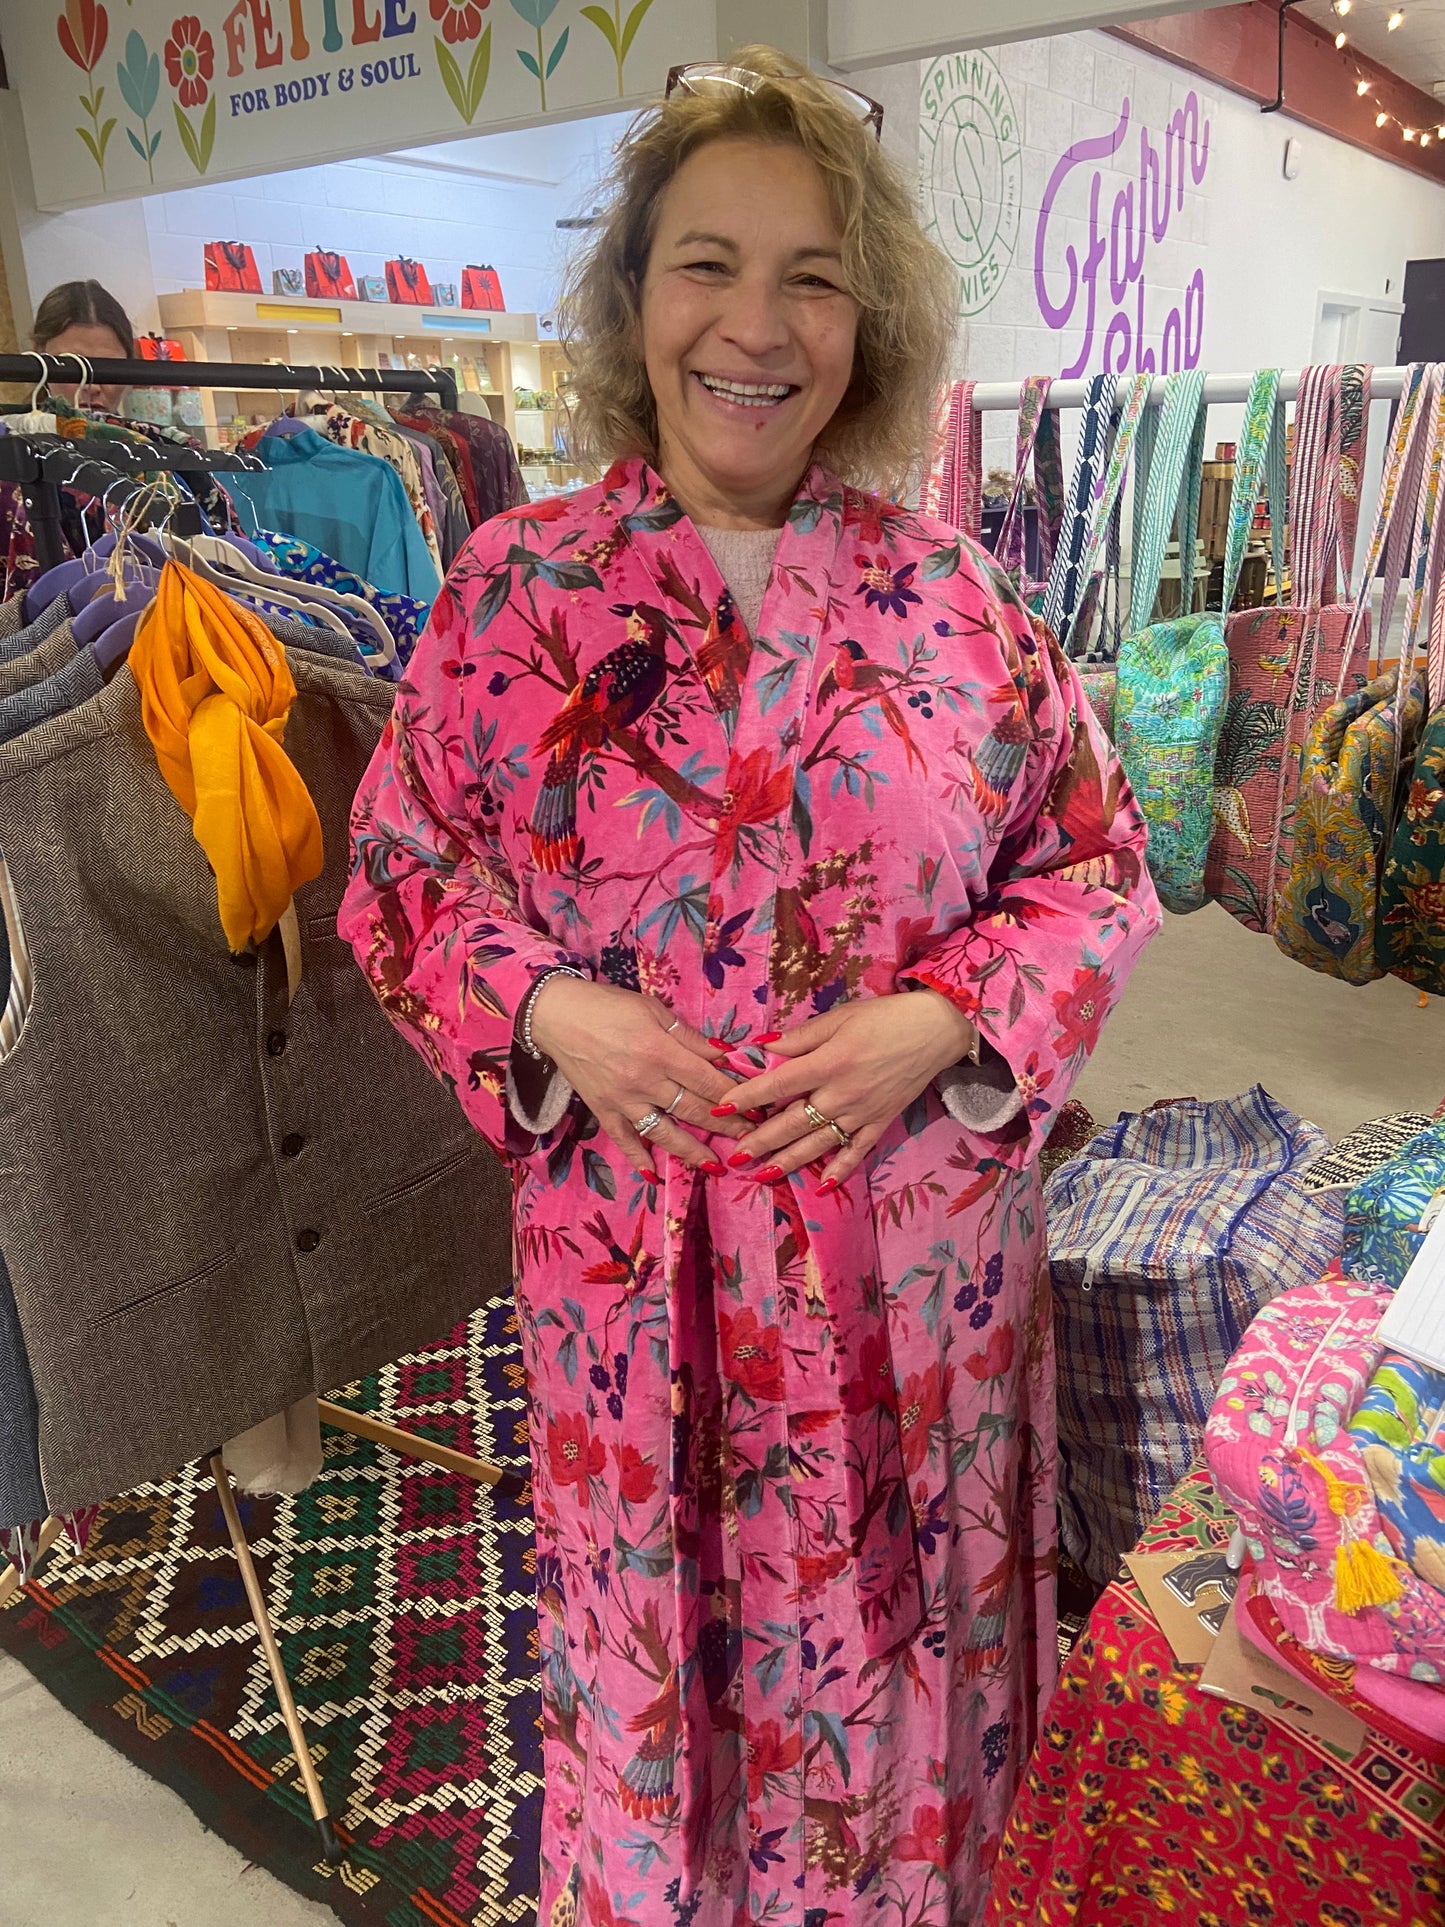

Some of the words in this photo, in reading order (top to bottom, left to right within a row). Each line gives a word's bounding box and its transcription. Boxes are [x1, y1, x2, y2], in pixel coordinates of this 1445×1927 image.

[229, 87, 270, 117] FOR
[274, 72, 331, 107] BODY
[338, 68, 354, 92] &
[361, 53, 421, 87] SOUL
[924, 54, 1013, 142] SPINNING
[1034, 90, 1210, 380] Farm
